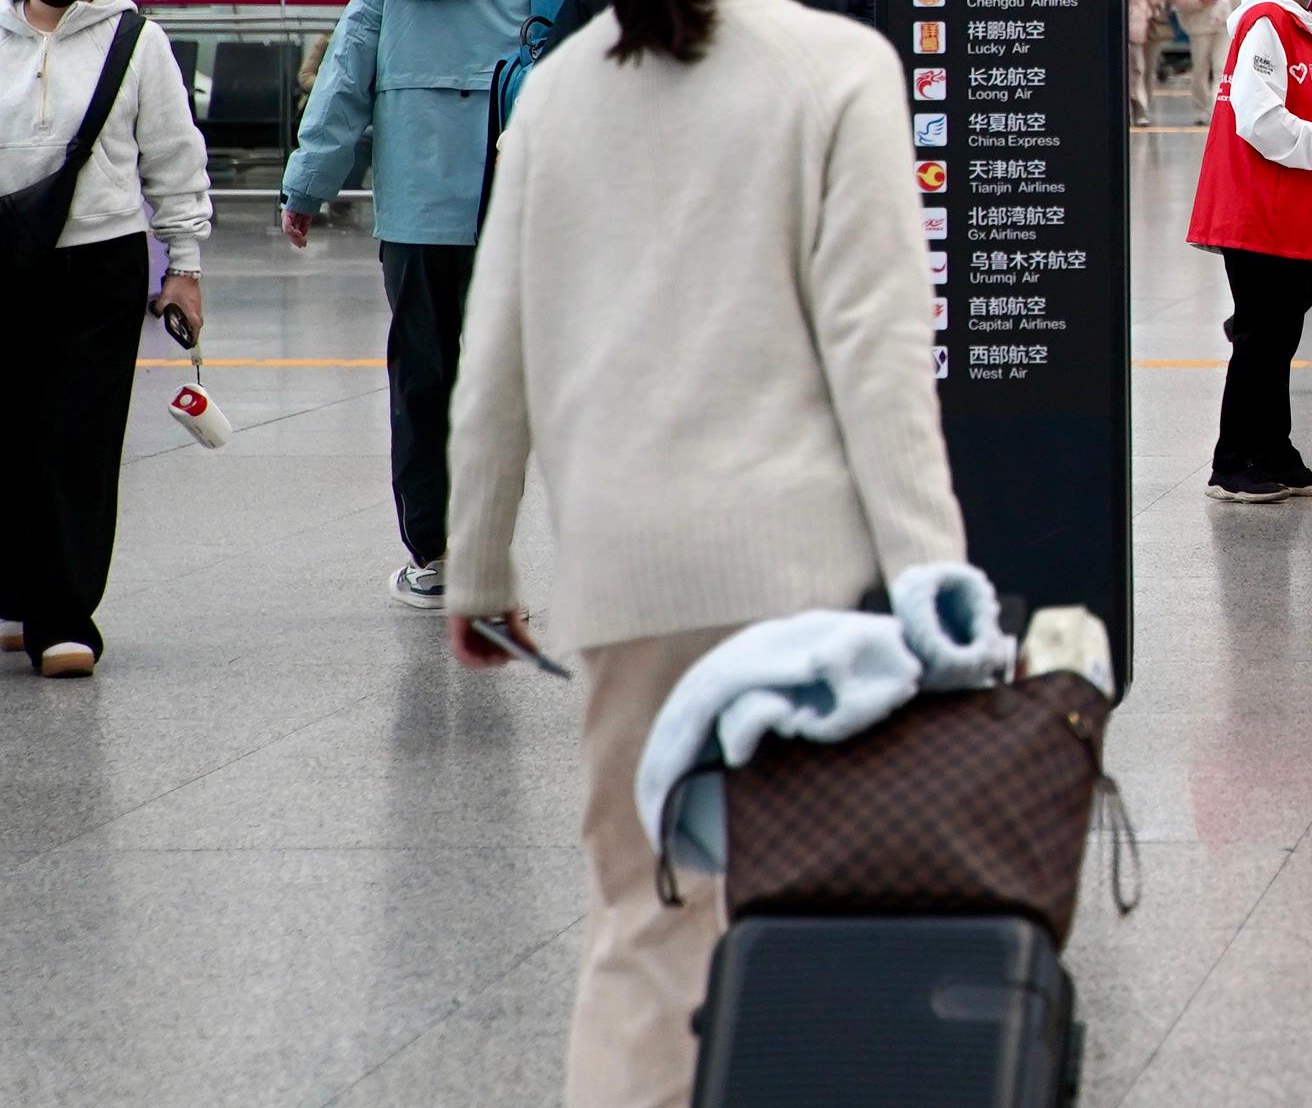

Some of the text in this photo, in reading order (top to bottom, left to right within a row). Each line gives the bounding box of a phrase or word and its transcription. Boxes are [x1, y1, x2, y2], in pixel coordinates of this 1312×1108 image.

[968, 21, 1044, 39] 祥鹏航空
[968, 43, 1030, 56] Lucky Air
[969, 67, 1045, 86] 长龙航空
[968, 88, 1032, 102] Loong Air
[969, 113, 1045, 132] 华夏航空
[969, 135, 1060, 148] China Express
[969, 160, 1045, 178] 天津航空
[970, 182, 1065, 195] Tianjin Airlines
[969, 207, 1064, 225] 北部湾航空
[968, 229, 1036, 240] Gx Airlines
[971, 251, 1086, 270] 乌鲁木齐航空
[970, 272, 1040, 285] Urumqi Air
[969, 297, 1045, 315] 首都航空
[969, 319, 1066, 332] Capital Airlines
[970, 345, 1047, 364] 西部航空
[969, 368, 1027, 379] West Air
